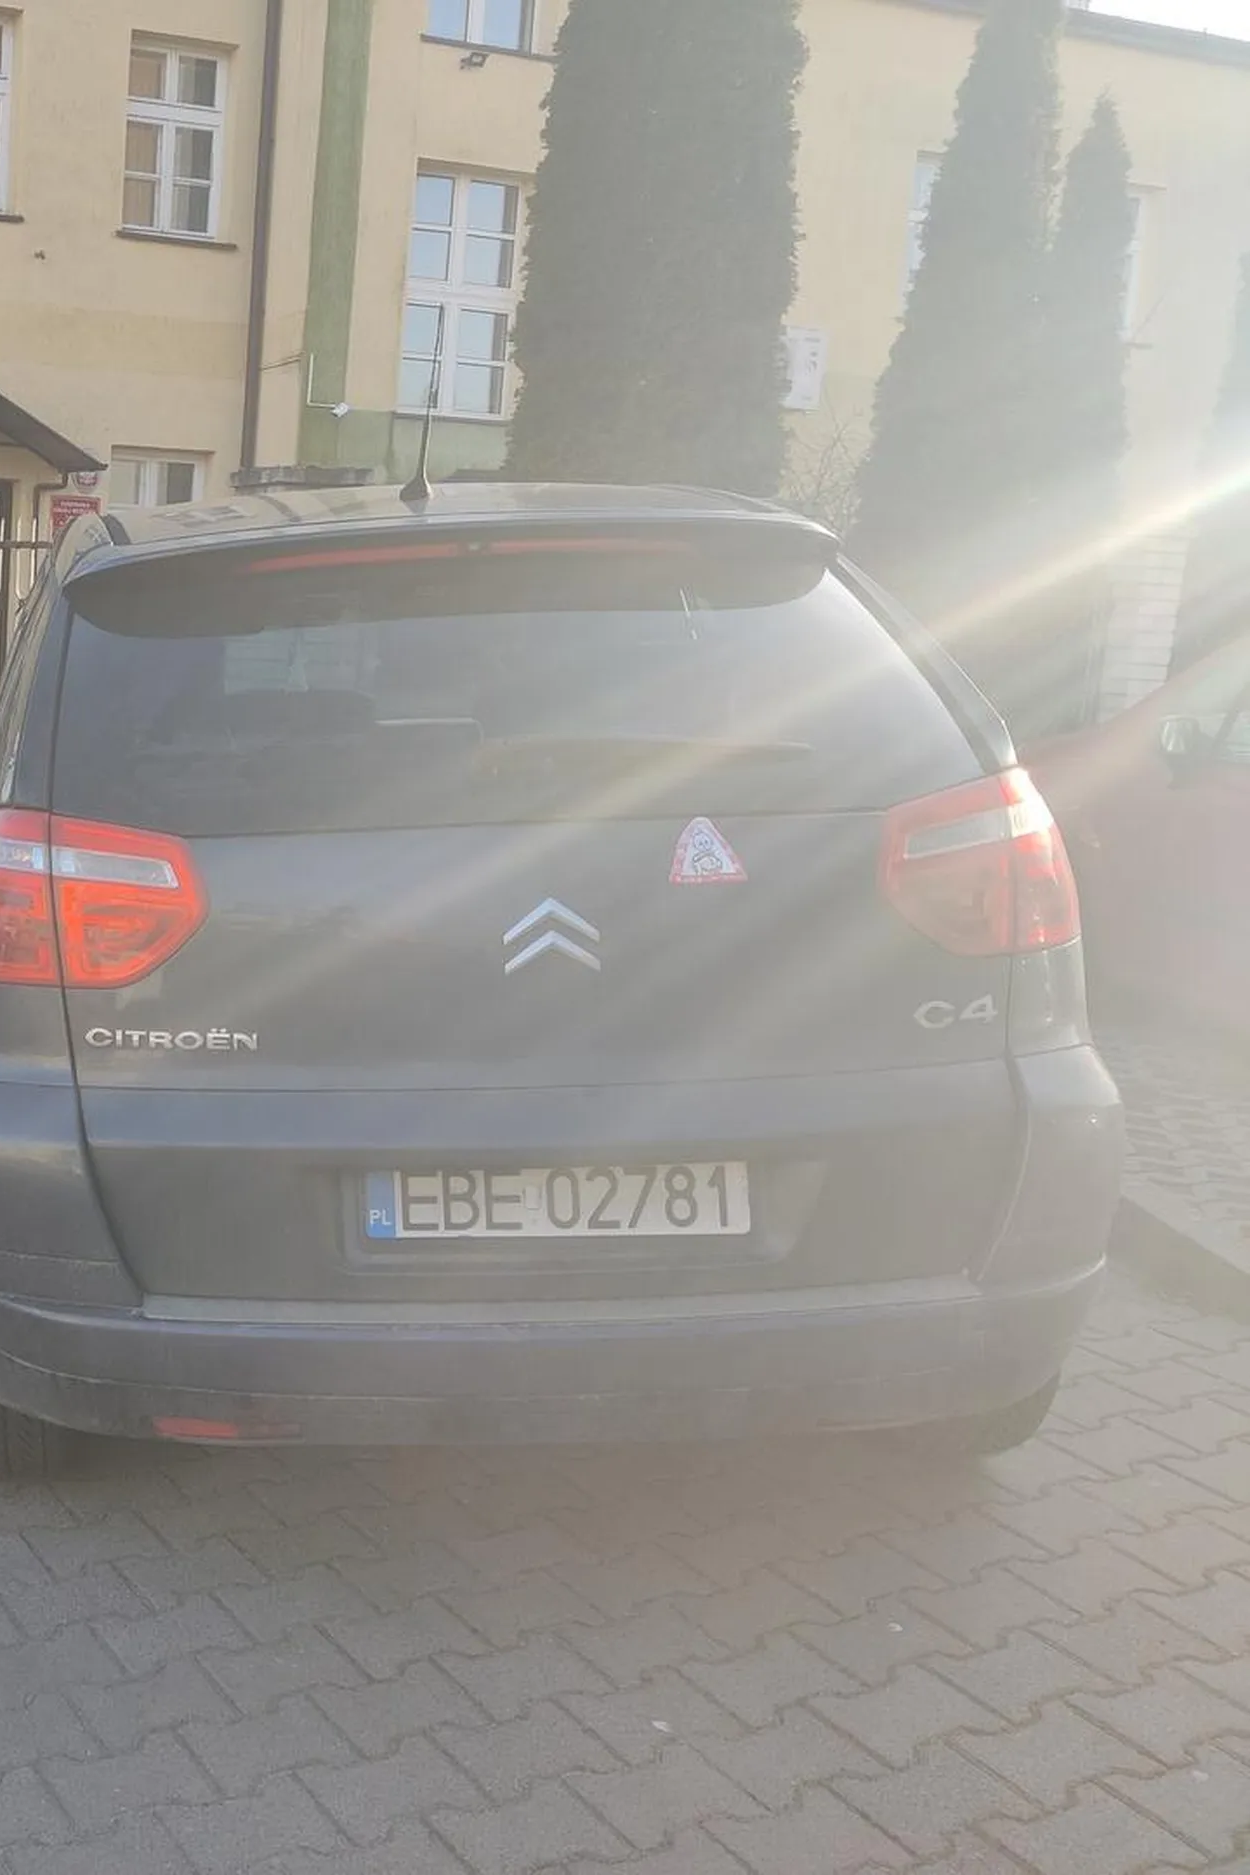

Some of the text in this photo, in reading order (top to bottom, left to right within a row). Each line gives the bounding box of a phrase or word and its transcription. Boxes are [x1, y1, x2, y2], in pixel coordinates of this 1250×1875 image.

[912, 994, 999, 1029] C4
[84, 1027, 258, 1051] CITROËN
[368, 1164, 730, 1232] PL EBE 02781
